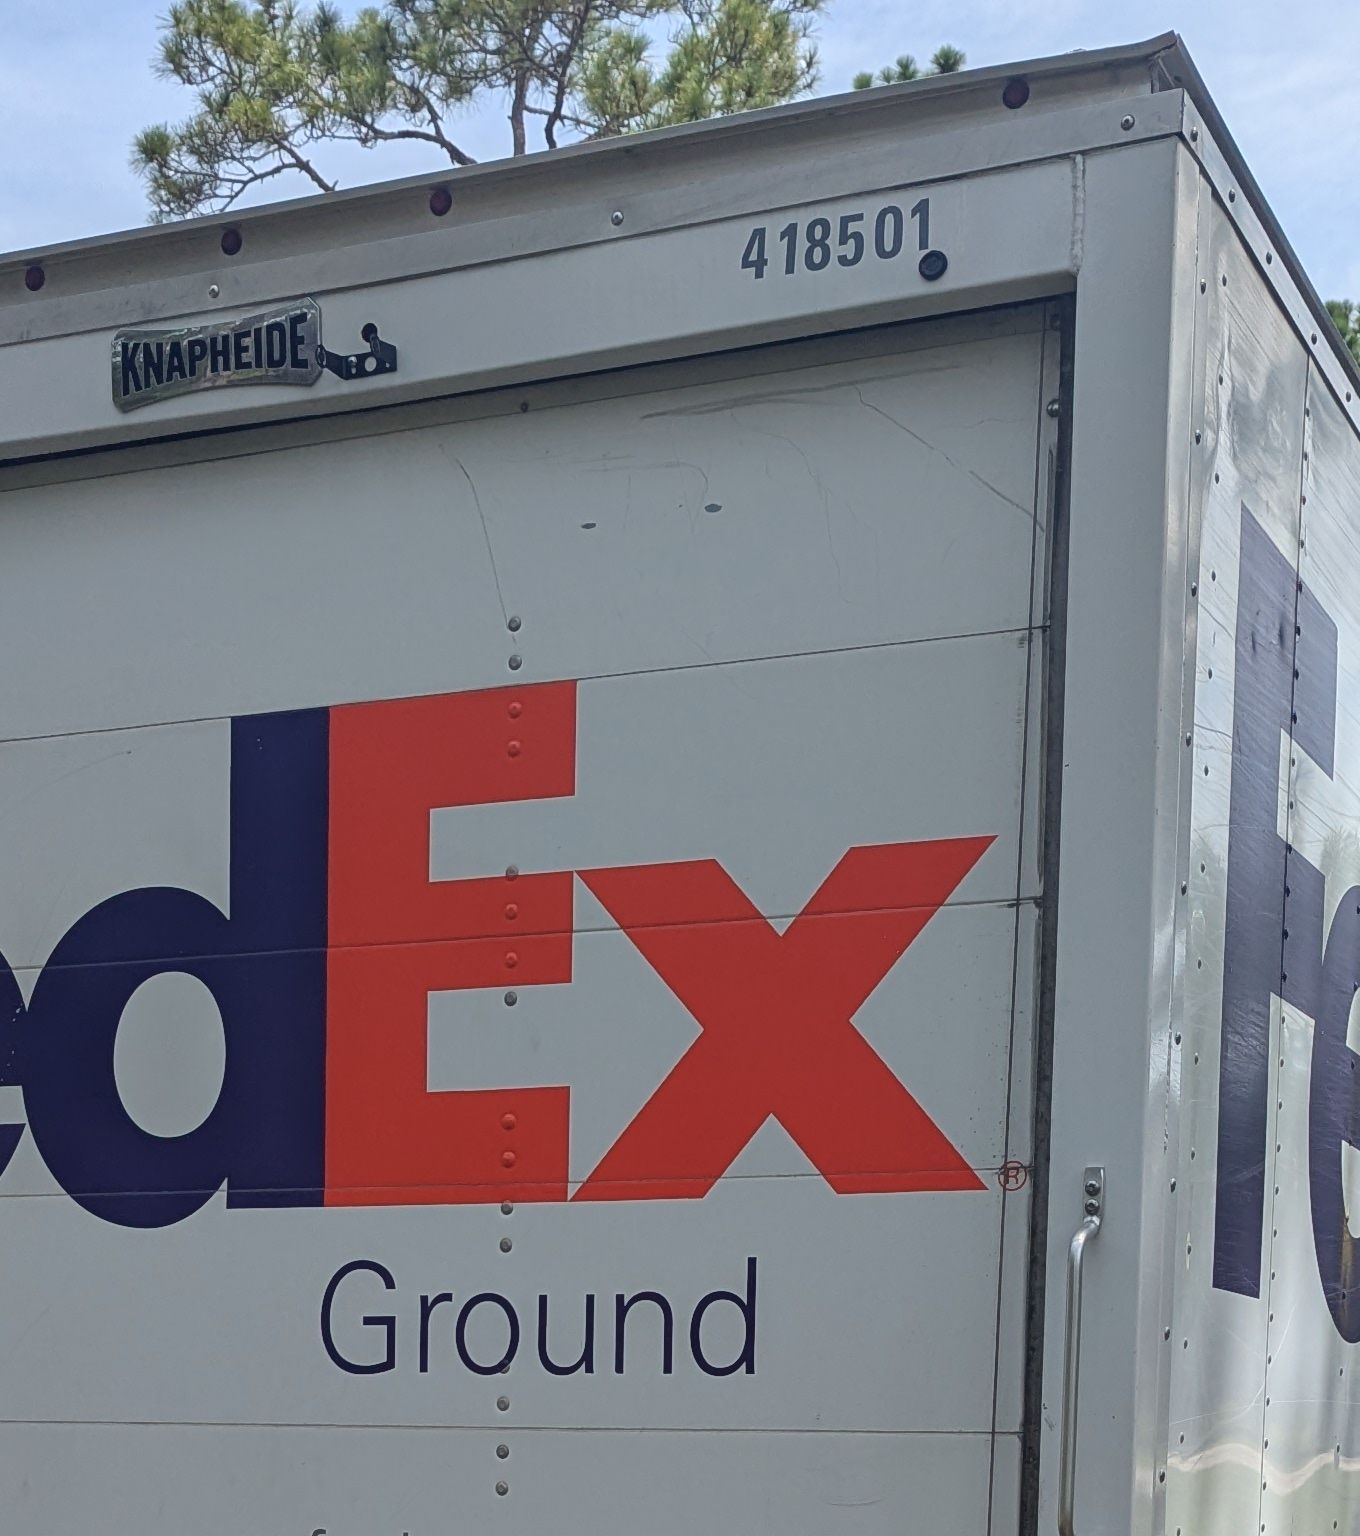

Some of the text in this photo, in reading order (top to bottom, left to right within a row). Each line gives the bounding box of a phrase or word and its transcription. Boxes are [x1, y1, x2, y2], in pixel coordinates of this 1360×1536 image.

[740, 197, 931, 280] 418501
[120, 311, 310, 397] KNAPHEIDE
[320, 1256, 758, 1377] Ground
